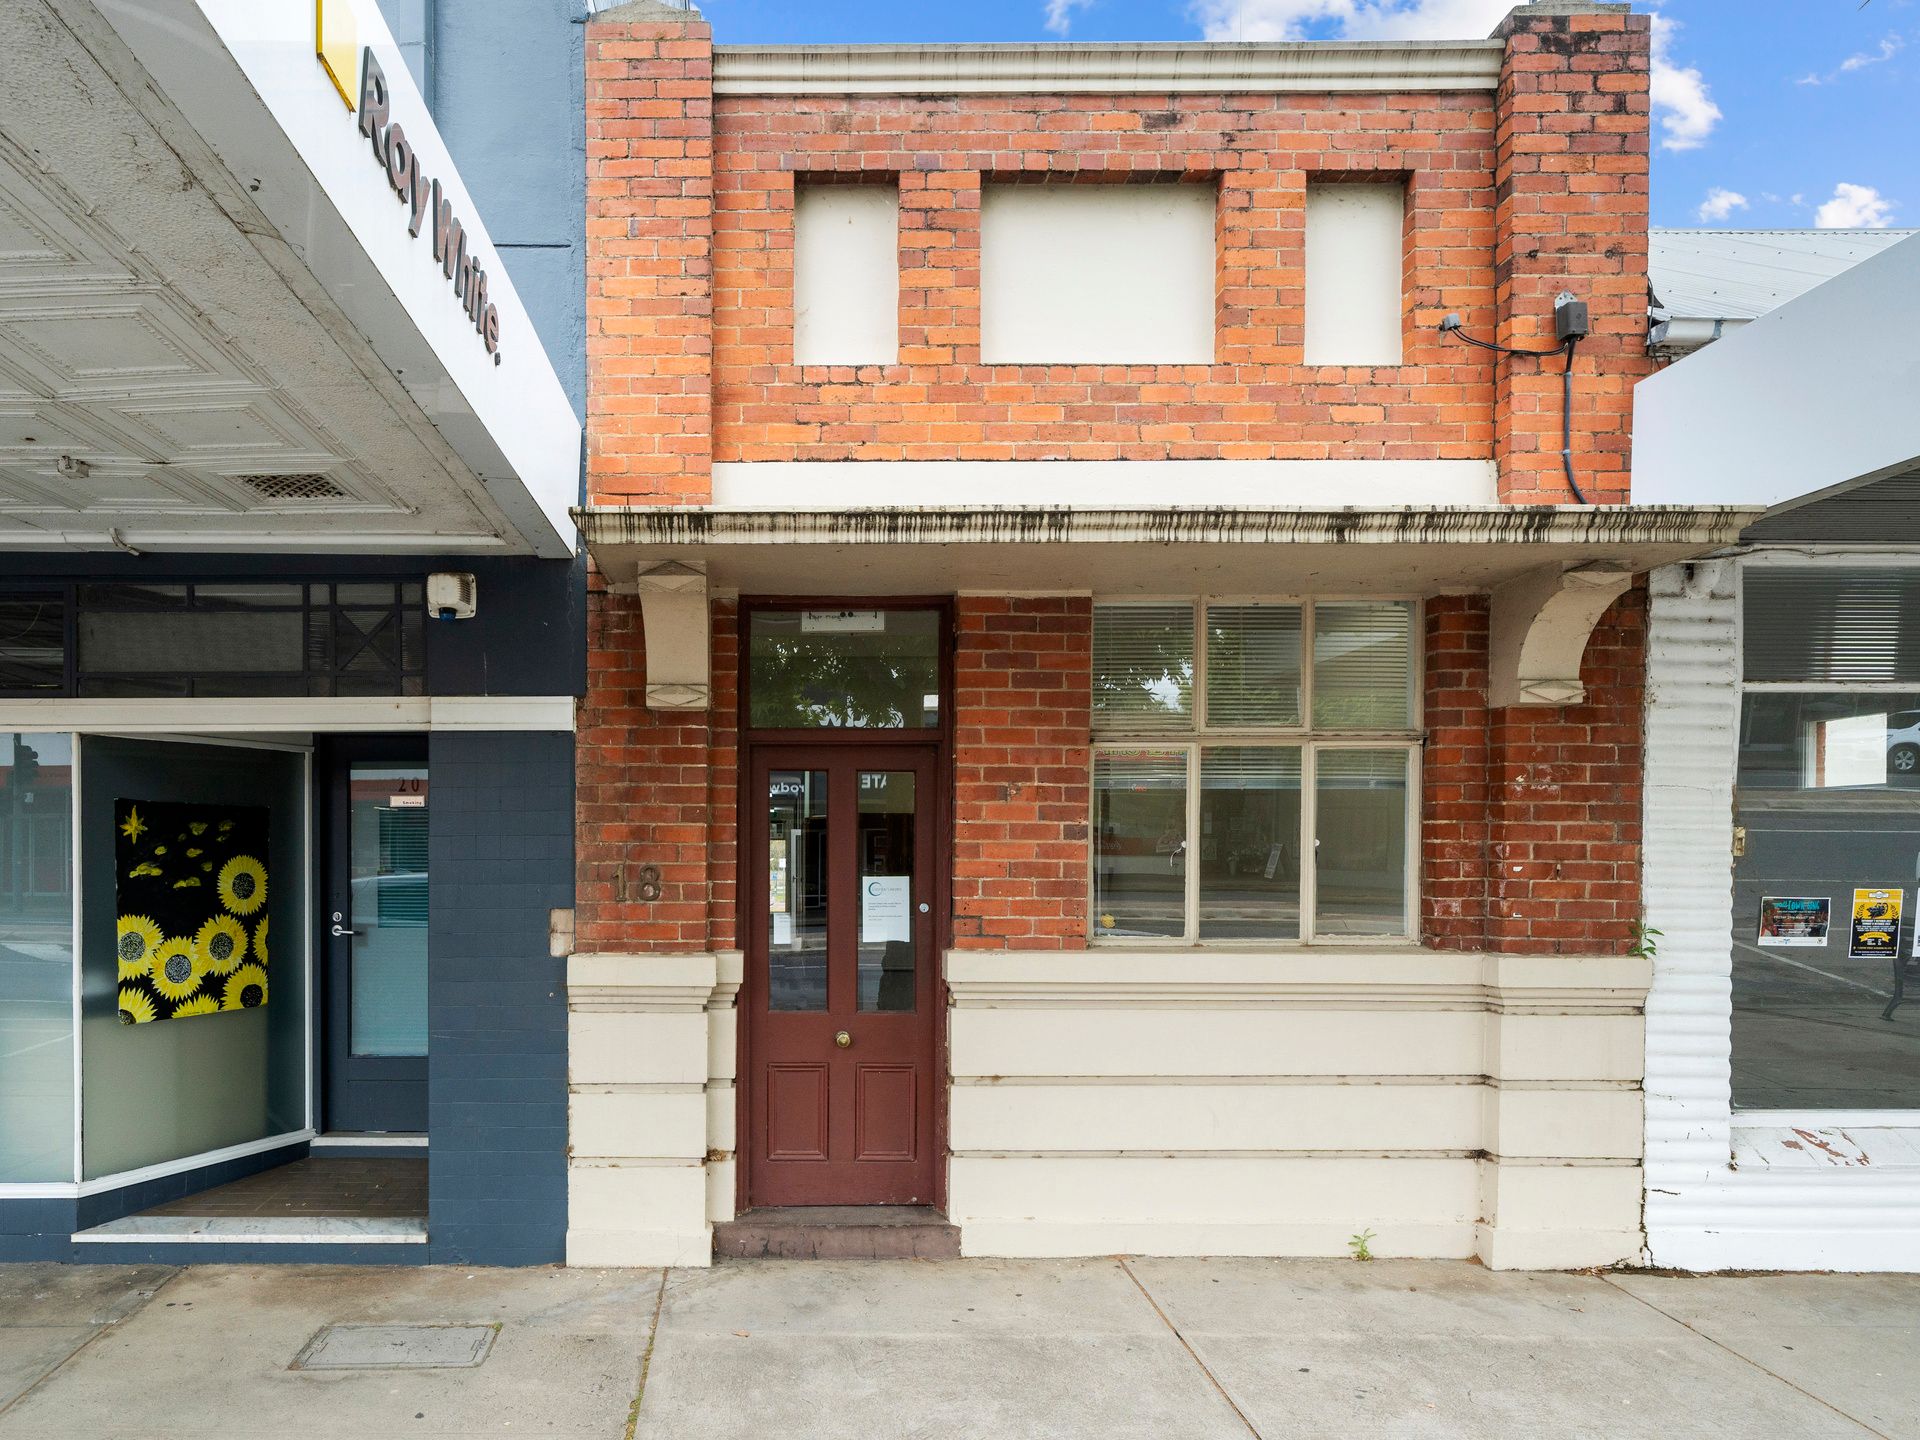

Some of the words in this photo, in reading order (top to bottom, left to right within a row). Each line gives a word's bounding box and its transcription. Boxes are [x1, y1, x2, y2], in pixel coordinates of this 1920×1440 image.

[359, 46, 431, 239] Ray
[399, 776, 420, 792] 20
[611, 864, 661, 901] 18
